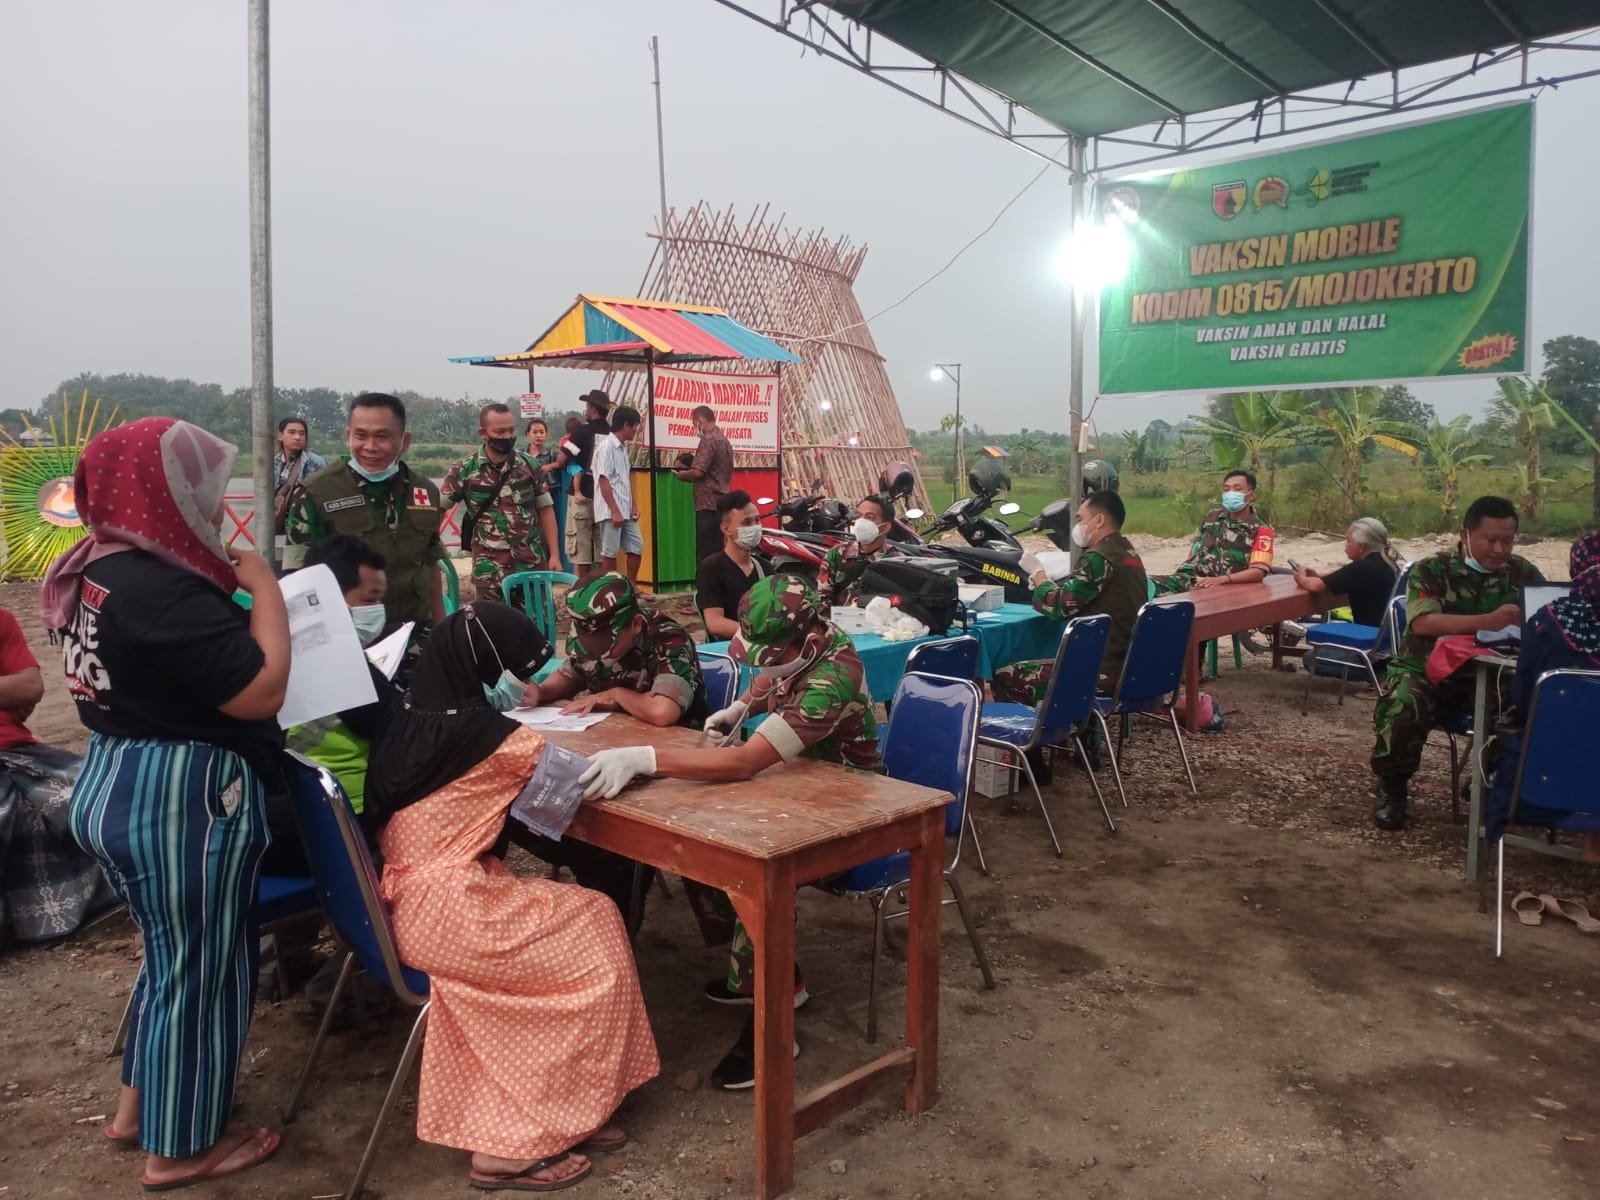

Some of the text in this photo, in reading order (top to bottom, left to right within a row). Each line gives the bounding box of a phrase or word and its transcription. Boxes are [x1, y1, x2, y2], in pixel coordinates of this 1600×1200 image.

[1190, 219, 1399, 275] VAKSIN MOBILE
[1132, 257, 1475, 324] KODIM 0815/MOJOKERTO
[1196, 313, 1387, 343] VAKSIN AMAN DAN HALAL
[1230, 340, 1346, 361] VAKSIN GRATIS
[655, 376, 711, 402] DILARANG
[654, 404, 674, 418] AREA
[719, 410, 743, 423] DALAM
[742, 411, 769, 424] PROSES
[725, 427, 752, 440] WISATA
[982, 563, 1021, 585] BABINSA
